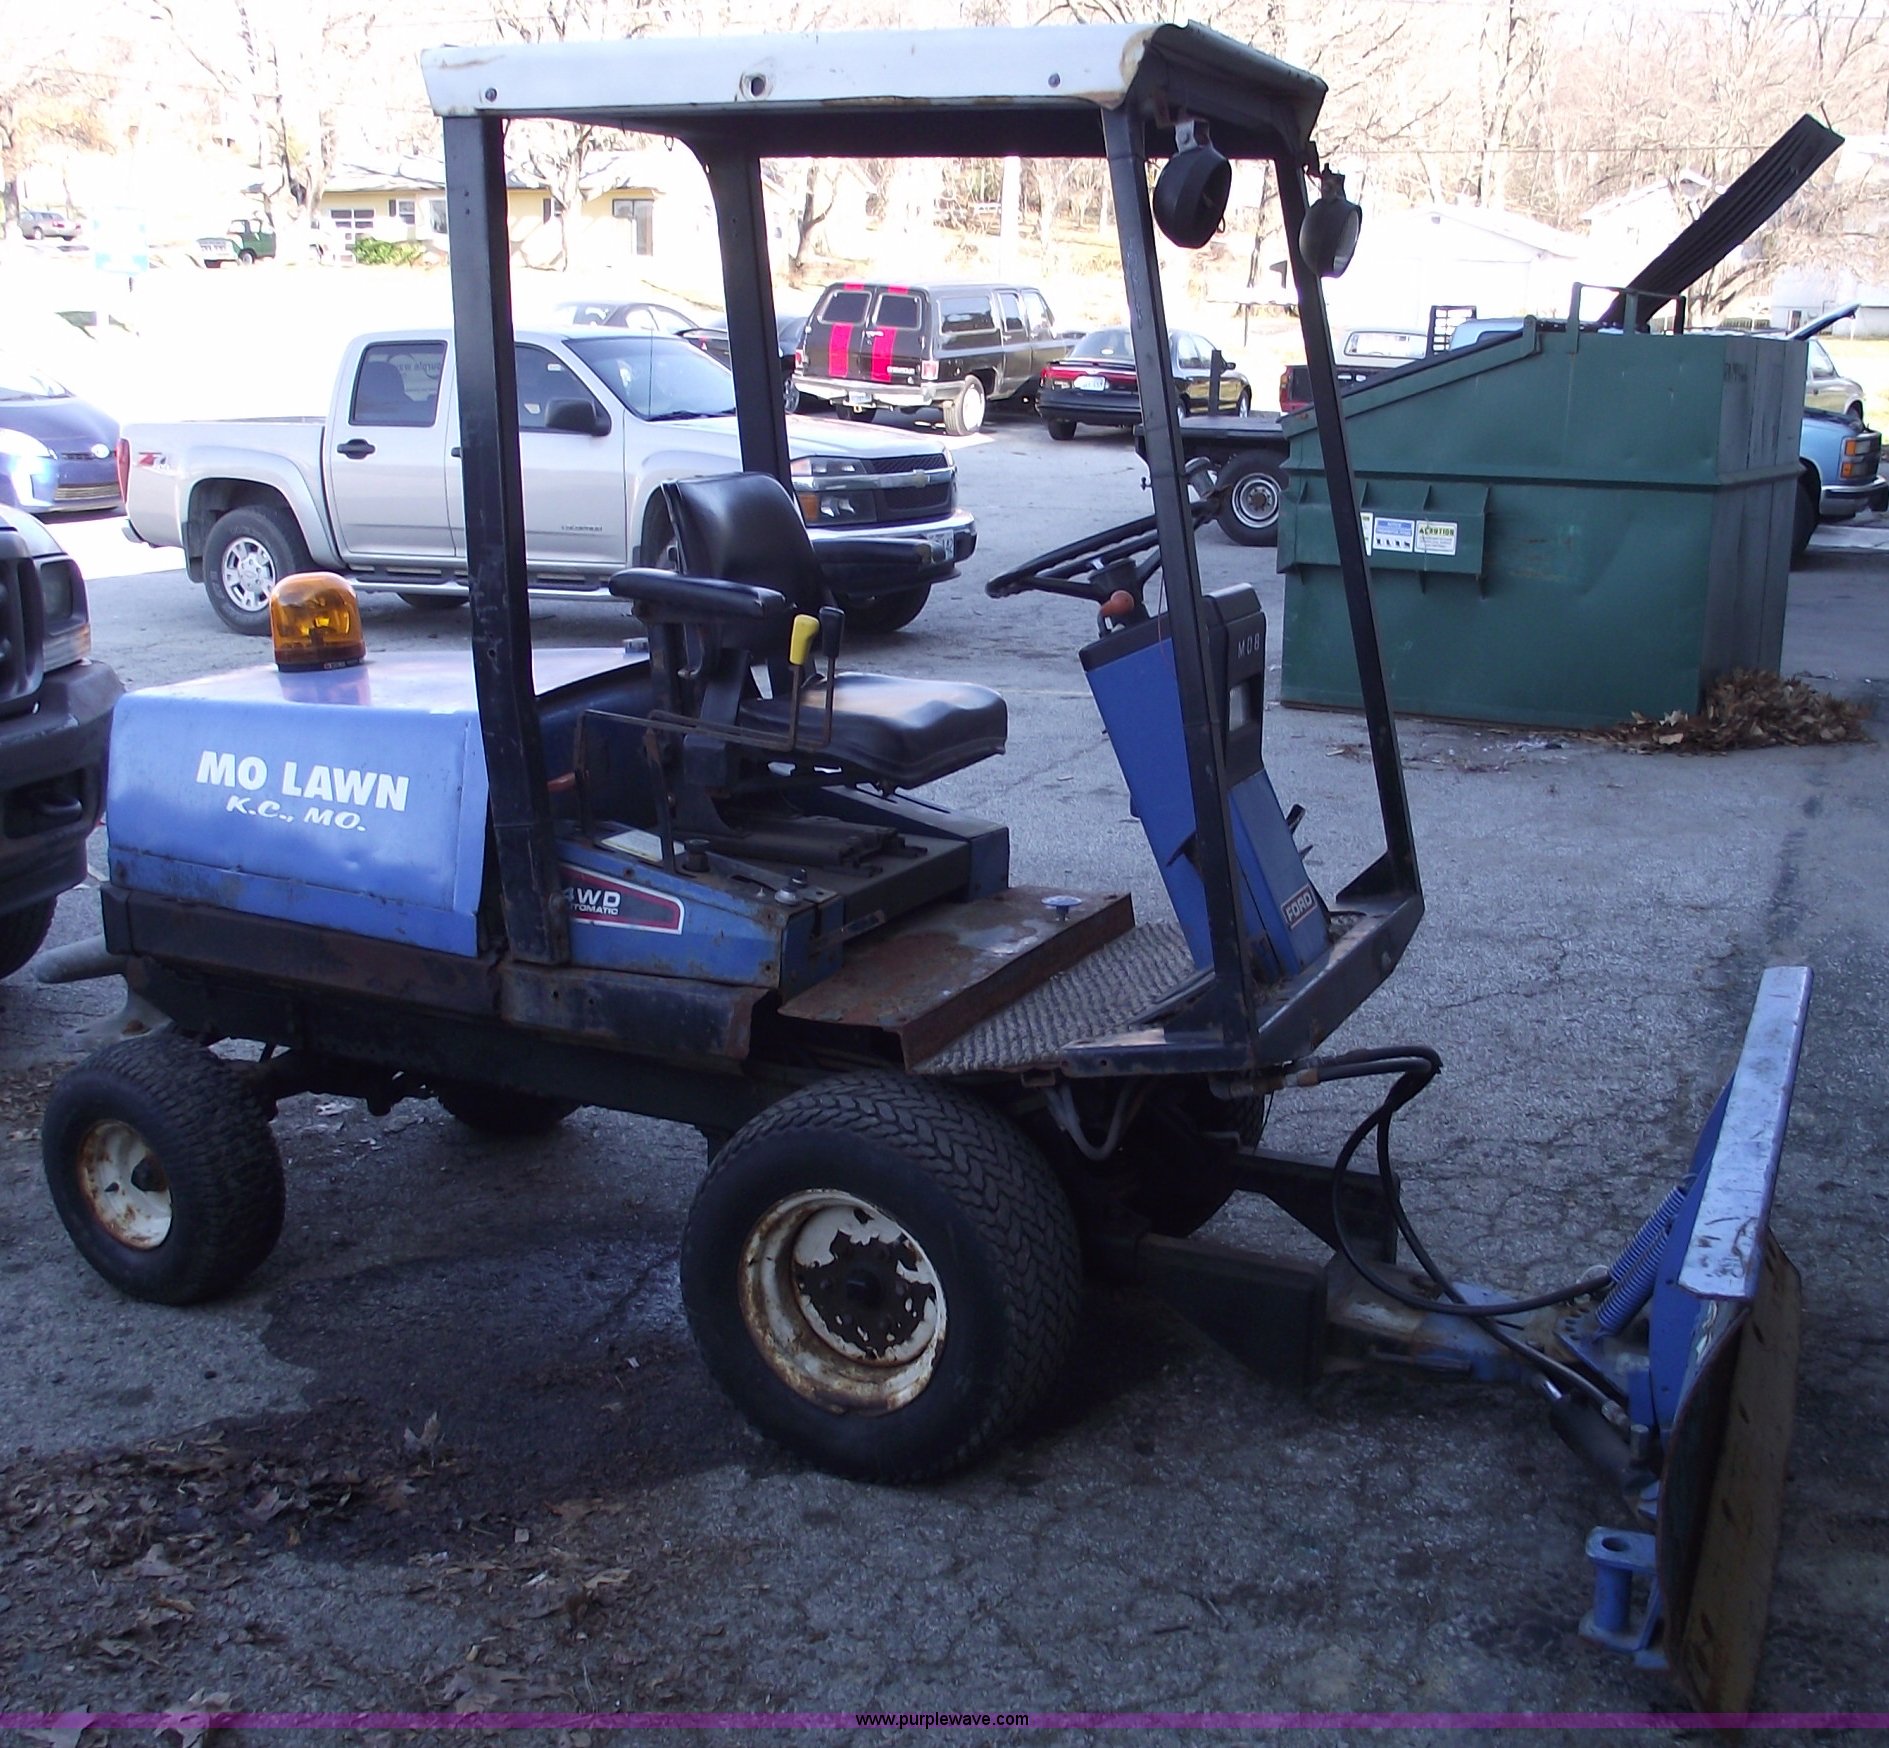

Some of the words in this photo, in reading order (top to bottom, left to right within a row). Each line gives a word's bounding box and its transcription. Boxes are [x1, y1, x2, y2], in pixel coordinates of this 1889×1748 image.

[196, 750, 268, 791] MO
[281, 760, 409, 812] LAWN
[226, 795, 294, 823] K.C.,
[304, 807, 366, 831] MO.
[562, 886, 621, 909] 4WD
[1285, 892, 1313, 922] FORD
